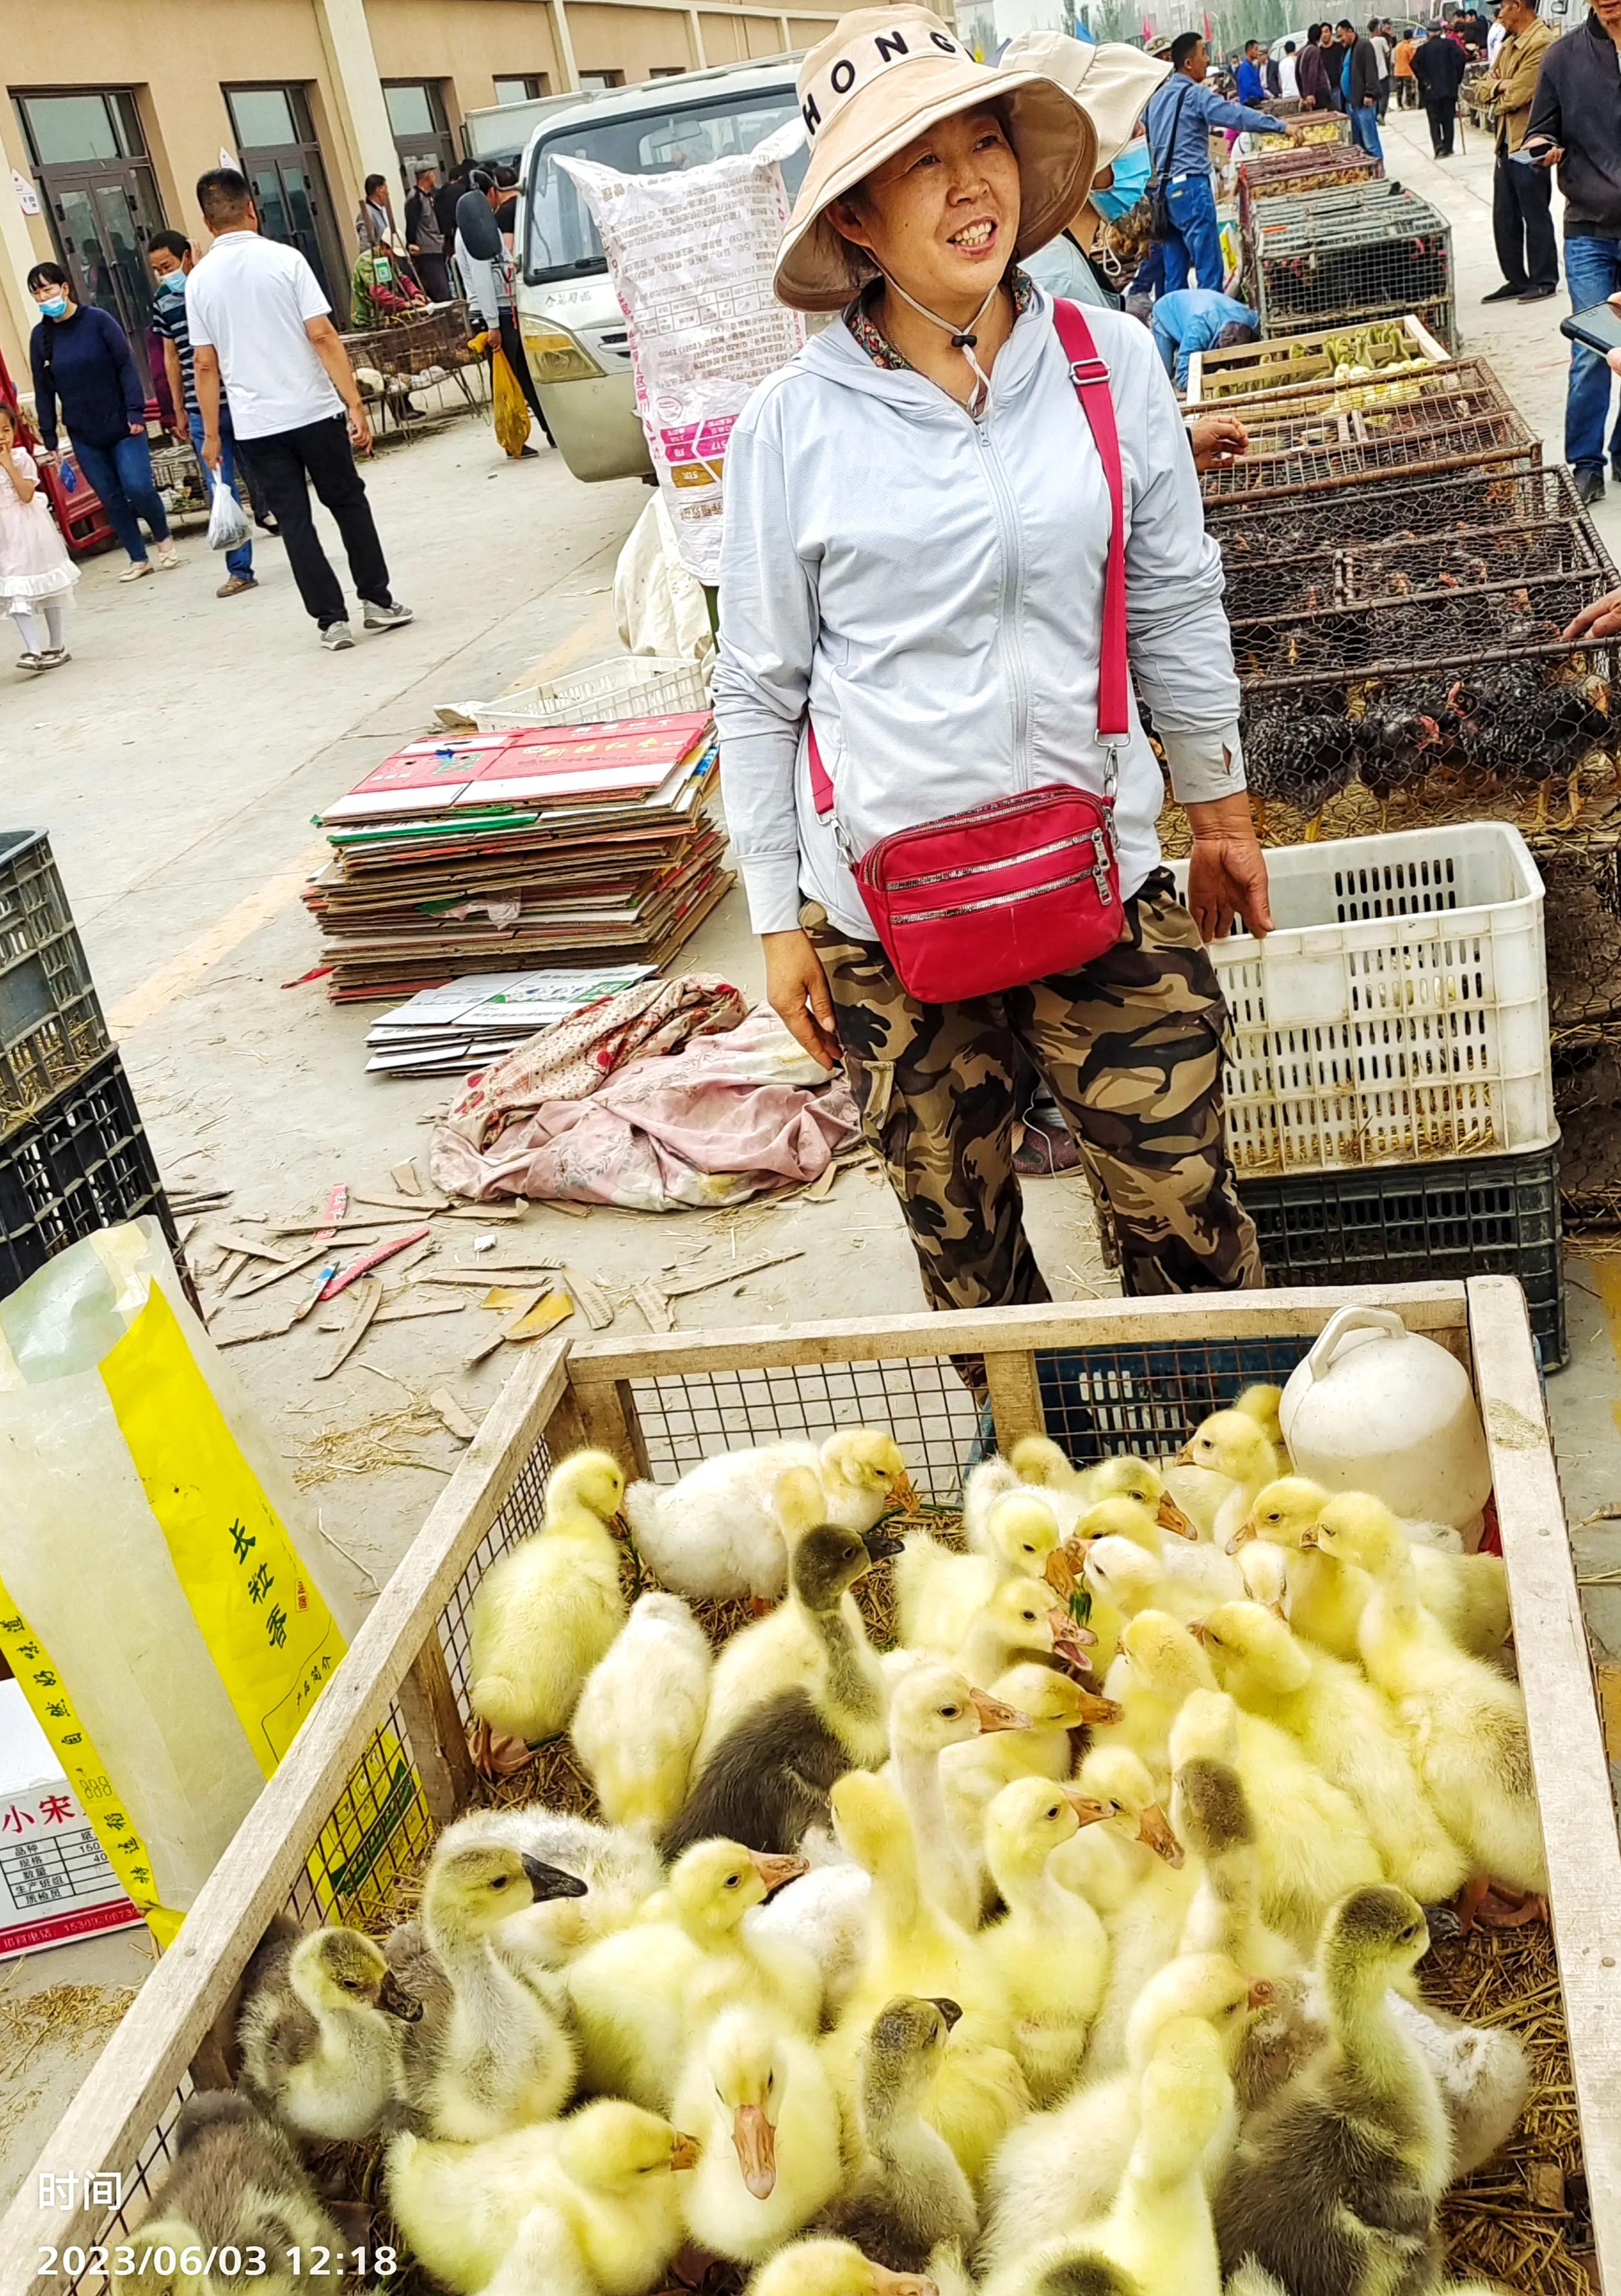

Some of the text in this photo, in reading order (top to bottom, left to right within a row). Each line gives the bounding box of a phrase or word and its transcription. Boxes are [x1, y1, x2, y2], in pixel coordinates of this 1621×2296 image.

[802, 31, 976, 135] HONG
[229, 1517, 287, 1649] 长粒香
[2, 1795, 87, 1834] 小宋
[15, 1845, 38, 1856] 品种
[19, 1857, 43, 1869] 规格
[23, 1867, 47, 1880] 数量
[15, 1876, 65, 1894] 生产班组
[26, 1890, 62, 1904] 质检员
